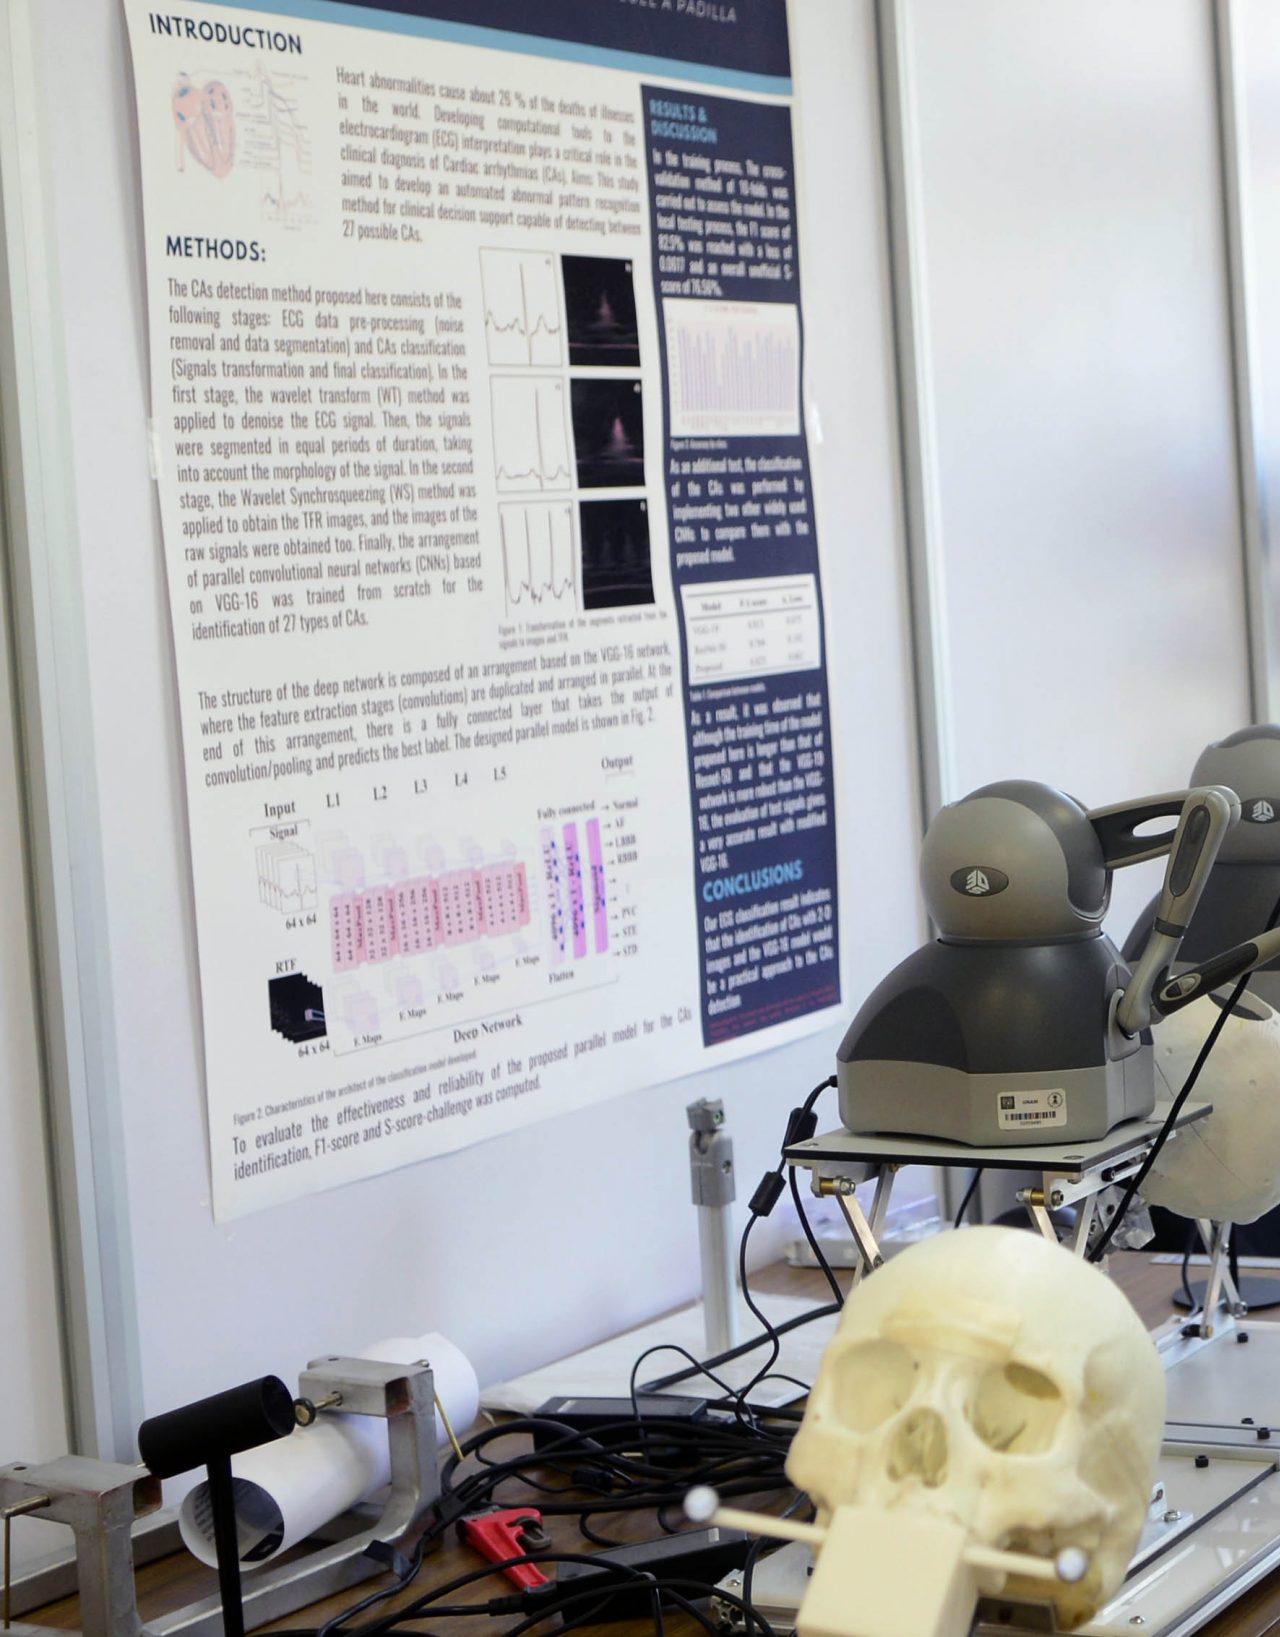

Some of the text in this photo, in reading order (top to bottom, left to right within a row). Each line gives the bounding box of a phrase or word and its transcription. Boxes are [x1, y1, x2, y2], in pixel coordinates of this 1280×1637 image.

[676, 0, 737, 22] PADILLA
[149, 14, 302, 54] INTRODUCTION
[336, 66, 365, 87] Heart
[370, 72, 435, 97] abnormalities
[439, 85, 465, 101] cause
[650, 99, 696, 122] RESULTS
[651, 120, 718, 144] DISCUSSION
[343, 219, 354, 237] 27
[358, 222, 398, 241] possible
[166, 236, 266, 262] METHODS:
[168, 277, 462, 309] The CAs detection method proposed here consists of the
[169, 305, 220, 329] following
[282, 309, 303, 328] ECG
[316, 311, 338, 329] data
[350, 316, 425, 335] pre-processing
[435, 316, 464, 336] (noise
[170, 332, 466, 358] removal and data segmentation) and CAs classification
[171, 358, 216, 381] (Signals
[222, 360, 304, 378] transformation
[310, 361, 328, 379] and
[334, 361, 356, 379] final
[438, 363, 448, 379] In
[452, 363, 467, 380] the
[218, 490, 236, 508] the
[242, 488, 285, 507] Wavelet
[290, 479, 385, 507] Synchrosqueezing
[390, 483, 414, 504] (WS)
[418, 482, 455, 500] method
[459, 485, 476, 498] was
[185, 547, 205, 561] raw
[210, 540, 248, 564] signals
[253, 543, 279, 558] were
[284, 536, 331, 556] obtained
[398, 531, 414, 549] the
[419, 526, 479, 551] arrangement
[188, 549, 481, 591] of parallel convolutional neural networks (CNNs) based
[190, 576, 483, 614] on VGG-16 was trained from scratch for the
[192, 618, 265, 640] identification
[269, 616, 279, 634] of
[284, 613, 295, 633] 27
[300, 614, 328, 634] types
[333, 610, 342, 628] of
[198, 691, 217, 710] The
[222, 687, 272, 708] structure
[277, 682, 287, 701] of
[292, 681, 309, 699] the
[314, 679, 339, 698] deep
[343, 672, 384, 693] network
[388, 672, 396, 688] is
[401, 665, 450, 688] composed
[455, 664, 464, 680] of
[601, 756, 632, 772] Output
[326, 766, 506, 808] L1 L2 L3 L4 L5
[264, 801, 296, 819] Input
[270, 824, 298, 840] Signal
[702, 860, 804, 902] CONCLUSIONS
[286, 918, 297, 930] 64
[306, 913, 317, 926] 64
[276, 959, 296, 973] RTF
[453, 1014, 522, 1044] Deep Network
[234, 1136, 246, 1155] To
[256, 1122, 302, 1149] evaluate
[311, 1114, 328, 1133] the
[337, 1095, 405, 1126] effectiveness
[414, 1083, 431, 1103] and
[439, 1070, 484, 1097] reliability
[491, 1063, 500, 1080] of
[508, 1058, 522, 1075] the
[529, 1042, 568, 1072] proposed
[315, 1131, 359, 1156] F1-score
[364, 1120, 381, 1142] and
[385, 1098, 472, 1136] S-score-challenge
[476, 1091, 493, 1108] was
